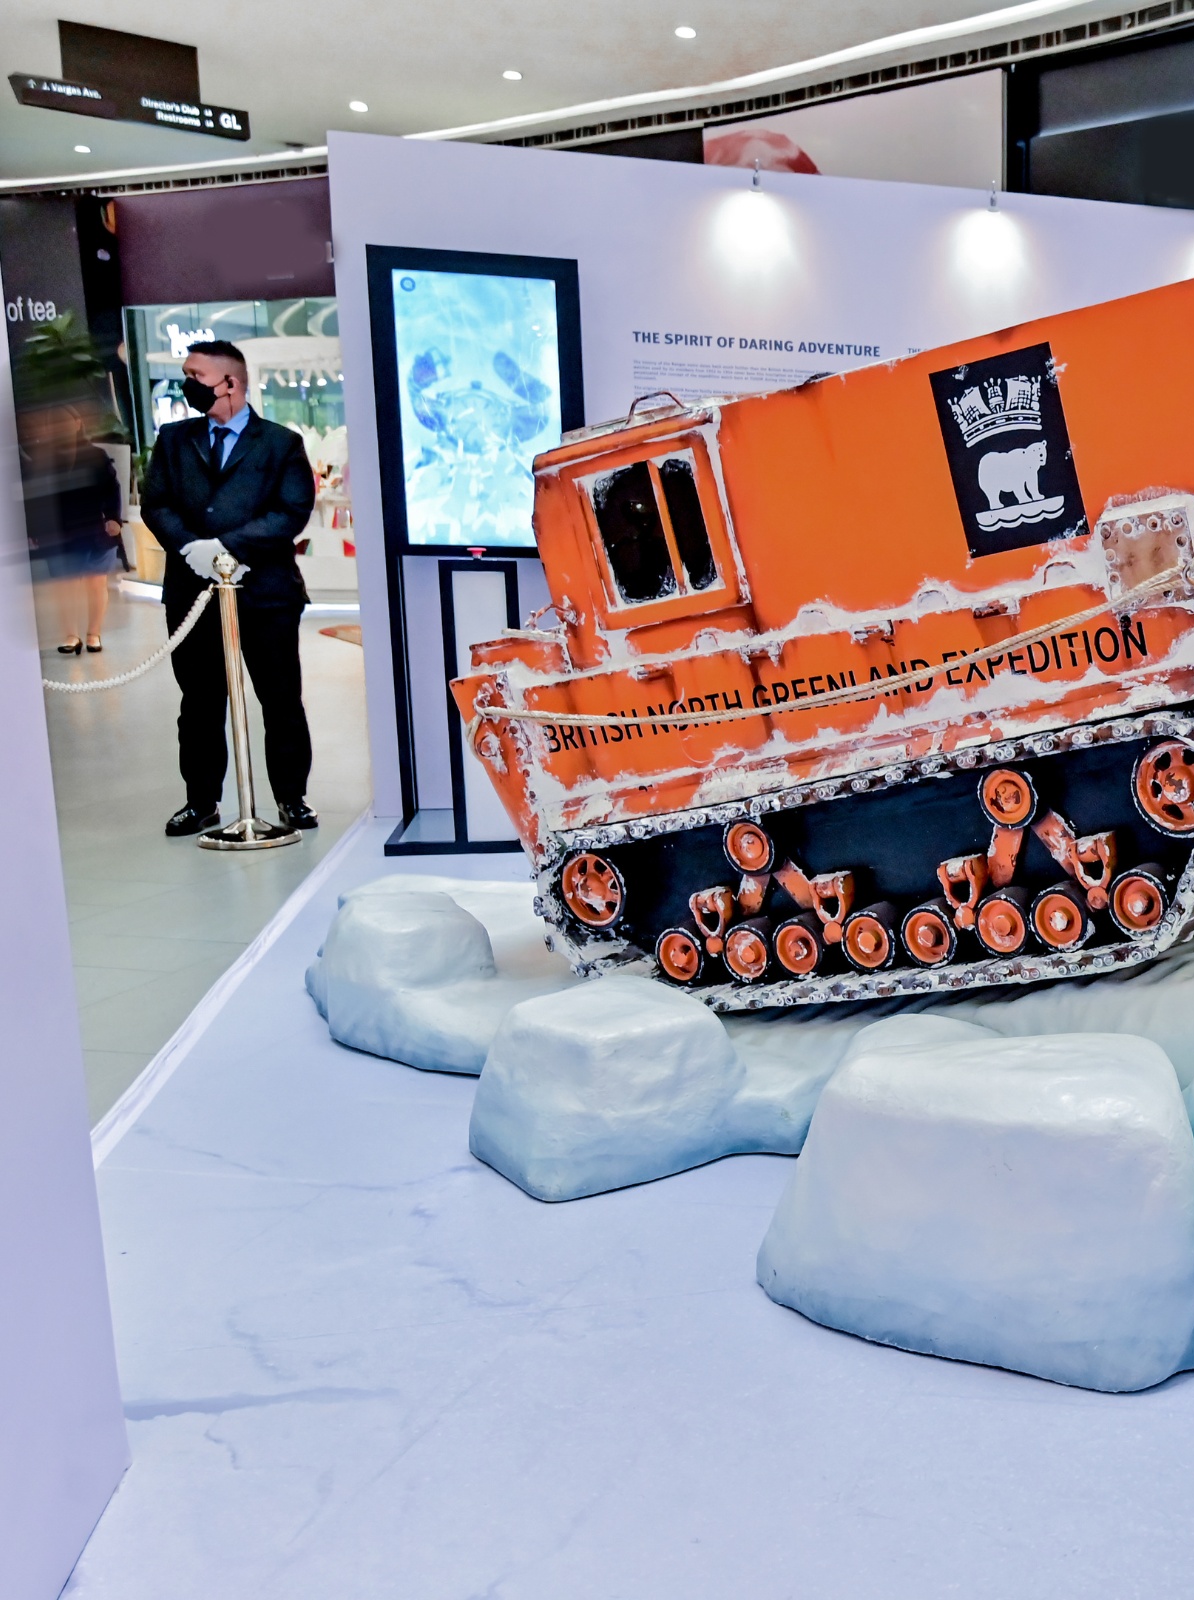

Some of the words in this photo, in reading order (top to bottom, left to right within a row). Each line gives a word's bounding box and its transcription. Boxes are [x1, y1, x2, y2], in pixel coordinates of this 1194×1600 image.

[51, 82, 81, 96] Vargas
[141, 96, 181, 113] Director's
[181, 103, 200, 116] Club
[156, 110, 201, 127] Restrooms
[219, 112, 242, 131] GL
[7, 295, 23, 321] of
[28, 297, 63, 322] tea.
[632, 331, 660, 344] THE
[664, 333, 713, 347] SPIRIT
[717, 336, 735, 348] OF
[739, 338, 793, 352] DARING
[798, 341, 881, 357] ADVENTURE
[543, 708, 644, 754] BRITISH
[647, 689, 745, 736] NORTH
[752, 658, 934, 717] GREENLAND
[942, 621, 1148, 686] EXPEDITION
